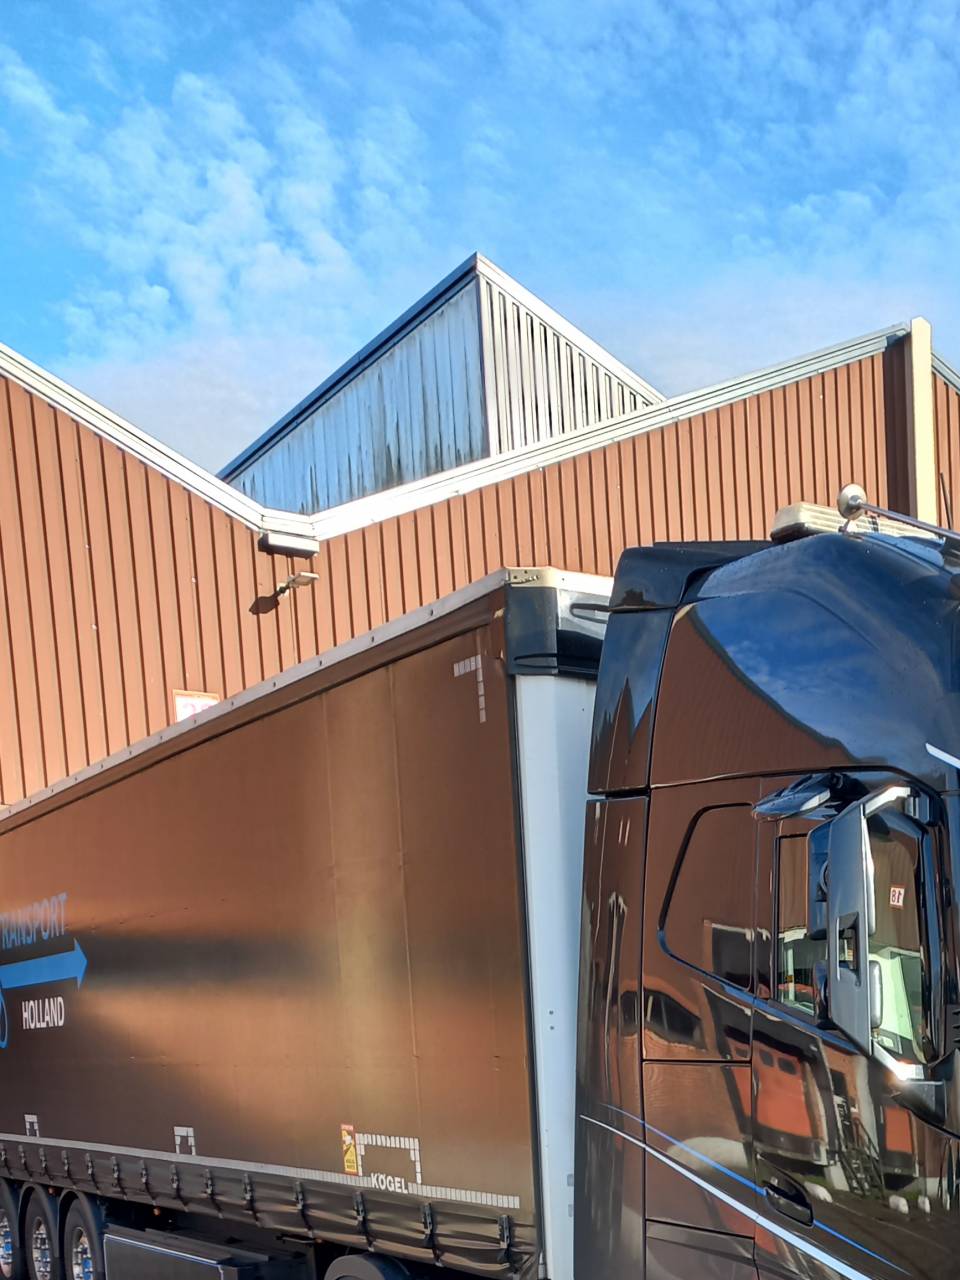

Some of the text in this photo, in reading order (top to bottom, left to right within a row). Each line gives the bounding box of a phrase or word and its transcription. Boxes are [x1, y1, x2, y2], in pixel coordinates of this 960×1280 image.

[0, 891, 68, 950] RANSPORT
[22, 996, 65, 1030] HOLLAND
[370, 1172, 409, 1194] KÖGEL
